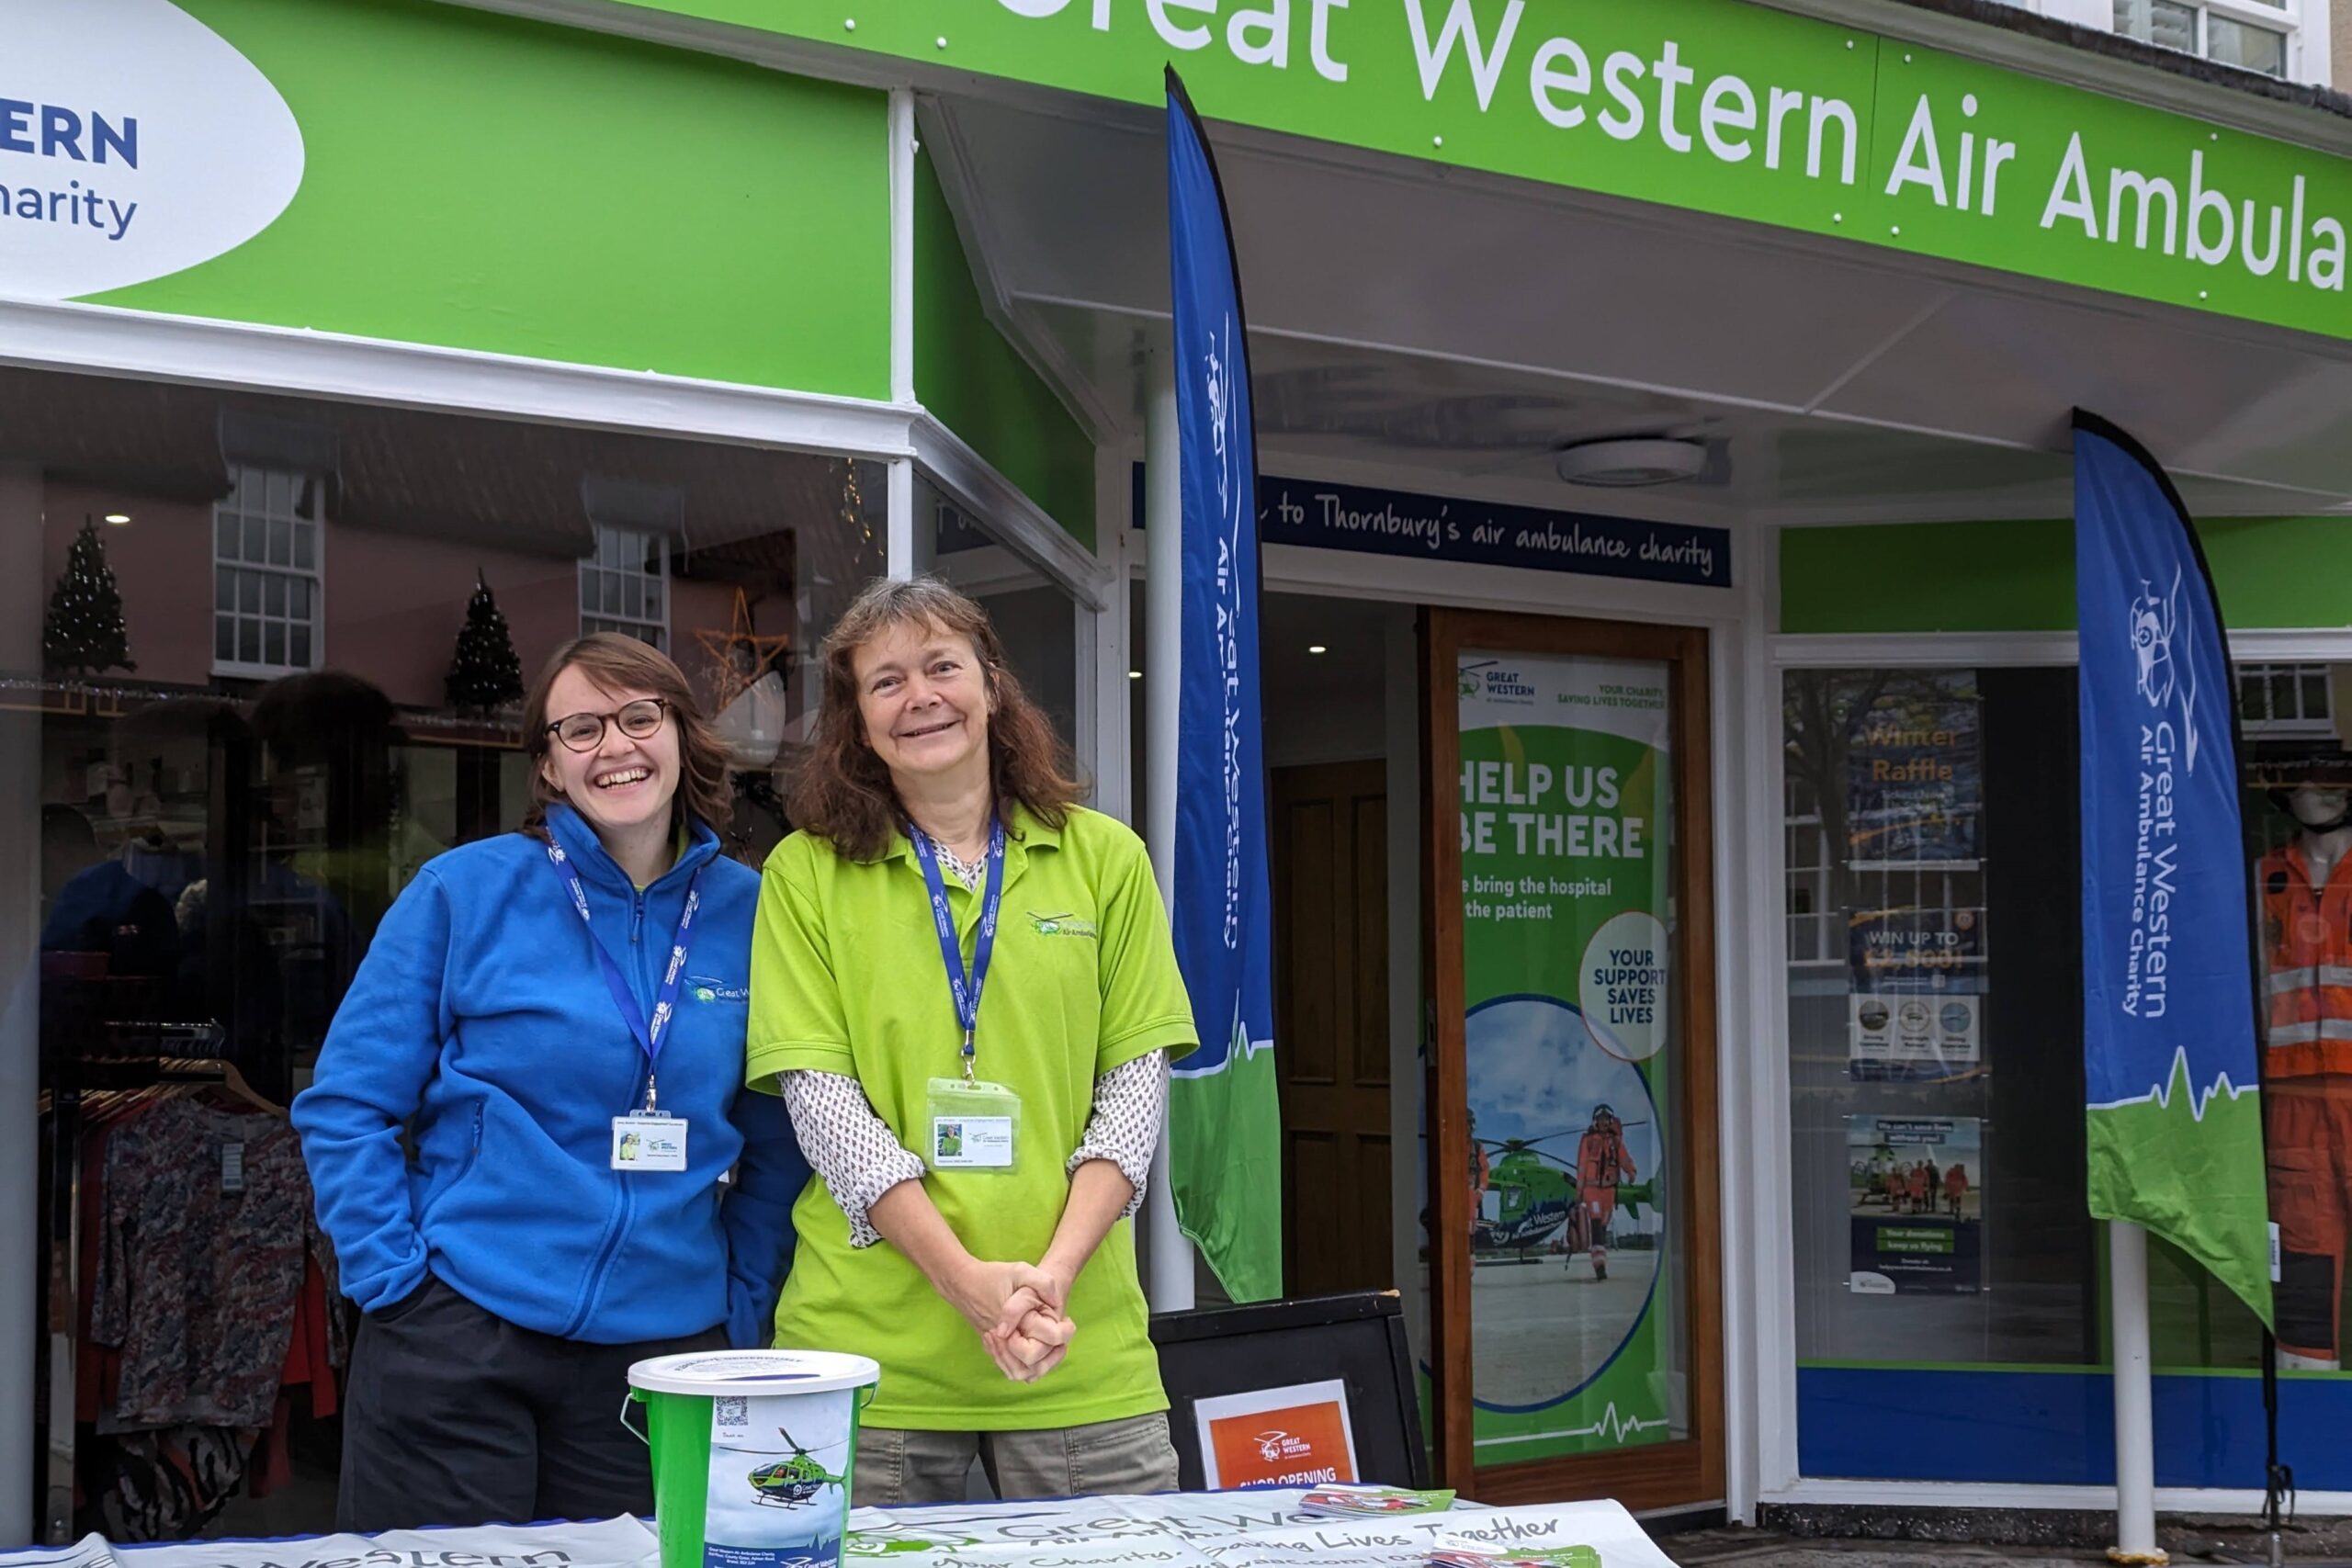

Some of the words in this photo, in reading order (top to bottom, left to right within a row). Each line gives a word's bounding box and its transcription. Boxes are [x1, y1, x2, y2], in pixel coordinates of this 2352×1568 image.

[1405, 0, 1858, 185] Western
[1884, 93, 2016, 218] Air
[2040, 130, 2346, 292] Ambula
[1277, 491, 1306, 525] to
[1314, 493, 1462, 549] Thornbury's
[1472, 518, 1506, 546] air
[1515, 525, 1632, 558] ambulance
[1638, 534, 1715, 577] charity
[1216, 536, 1229, 594] Air
[1486, 671, 1520, 683] GREAT
[1487, 683, 1535, 696] WESTERN
[2141, 725, 2154, 765] Air
[1872, 759, 1953, 782] Raffle
[2155, 721, 2177, 837] Great
[1565, 765, 1619, 808] US
[1508, 813, 1645, 858] THERE
[2132, 772, 2154, 923] Ambulance
[1473, 874, 1514, 897] bring
[1519, 876, 1545, 894] the
[1549, 876, 1611, 899] hospital
[1464, 900, 1491, 918] the
[1495, 902, 1553, 921] patient
[1869, 931, 1904, 945] WIN
[1908, 931, 1930, 945] UP
[1934, 931, 1960, 946] TO
[2145, 843, 2177, 1017] Western
[1610, 949, 1654, 967] YOUR
[1594, 968, 1667, 987] SUPPORT
[2122, 929, 2144, 1016] Charity
[1607, 988, 1656, 1006] SAVES
[1610, 1007, 1654, 1024] LIVES
[1281, 1437, 1300, 1448] GREAT
[1283, 1442, 1312, 1454] WESTERN
[1278, 1467, 1337, 1485] OPENING
[1316, 1530, 1413, 1554] Lives
